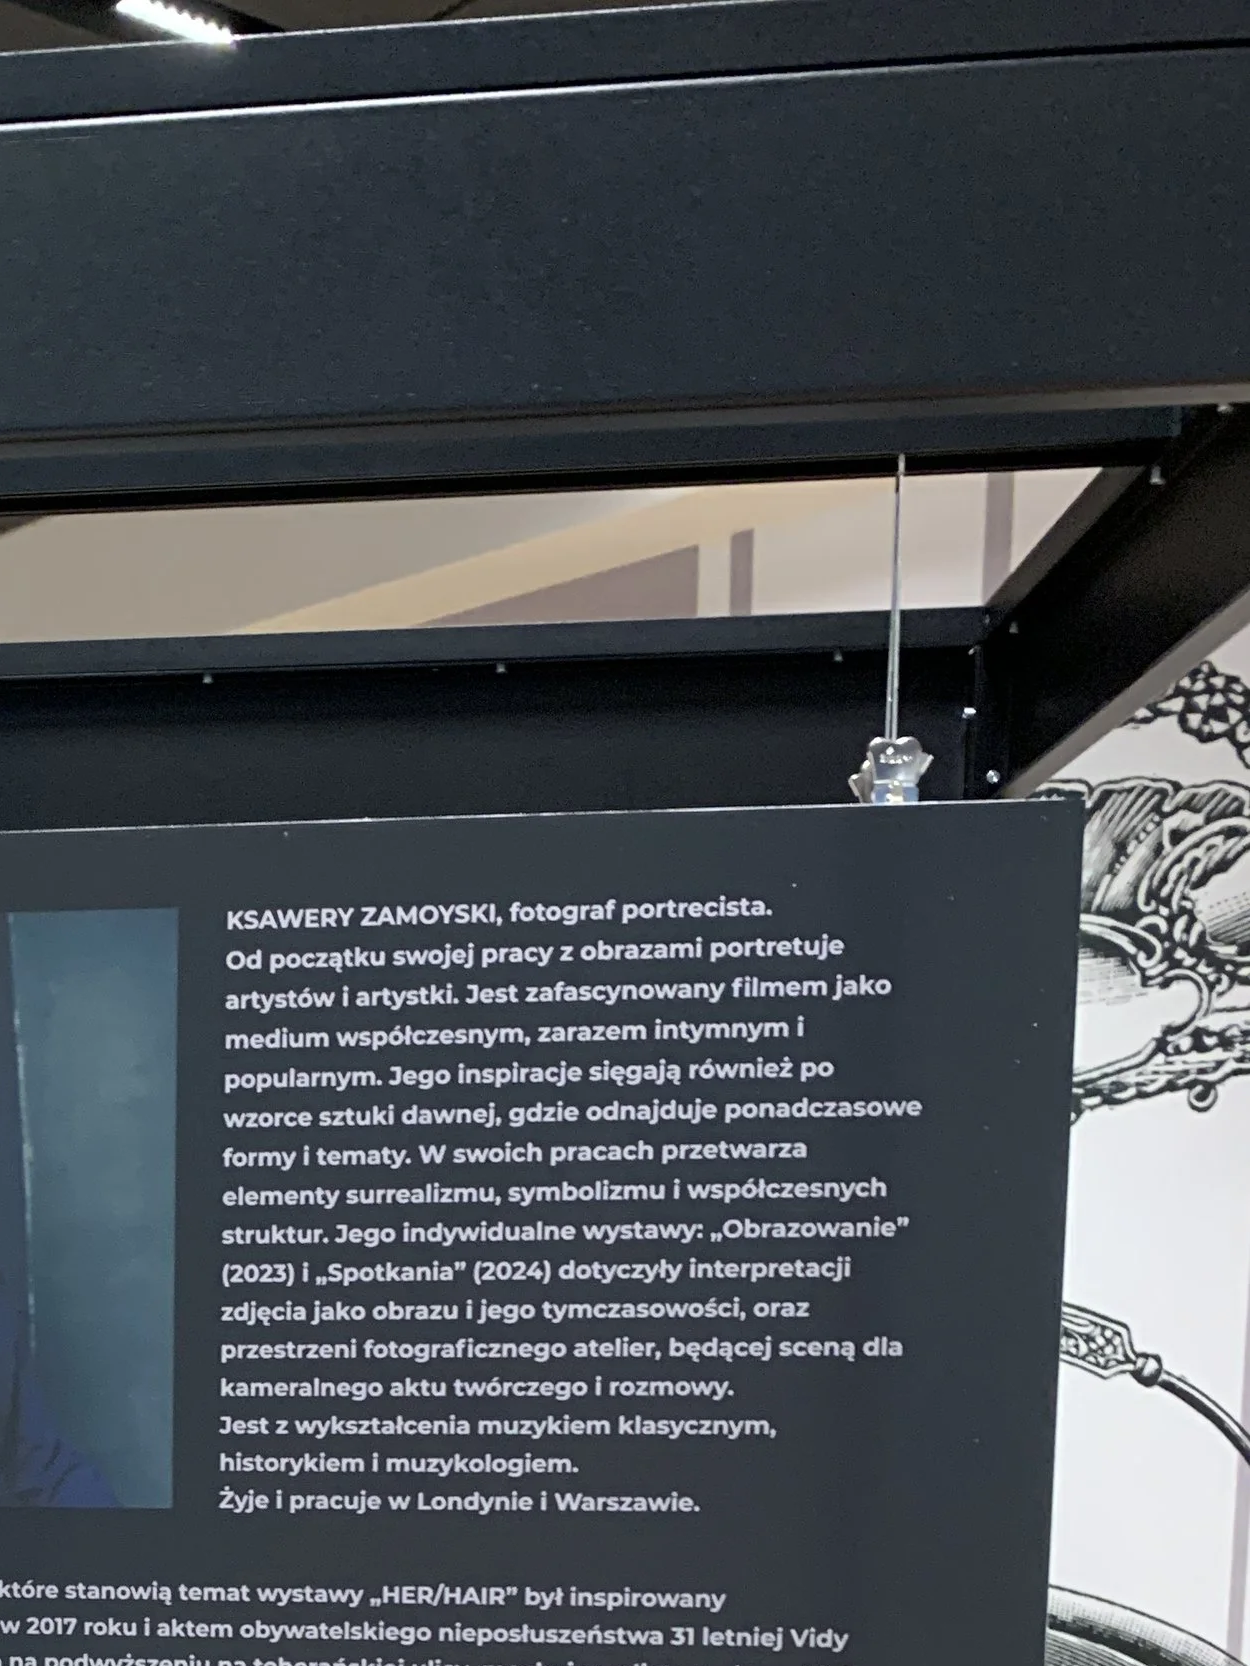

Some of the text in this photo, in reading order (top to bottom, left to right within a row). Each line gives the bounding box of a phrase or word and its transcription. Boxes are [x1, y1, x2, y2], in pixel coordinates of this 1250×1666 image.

[226, 894, 774, 931] KSAWERY ZAMOYSKI, fotograf portrecista.
[225, 932, 846, 975] Od początku swojej pracy z obrazami portretuje
[224, 1014, 805, 1052] medium współczesnym, zarazem intymnym i
[224, 1055, 835, 1094] popularnym. Jego inspiracje sięgają również po
[222, 1096, 923, 1129] wzorce sztuki dawnej, gdzie odnajduje ponadczasowe
[221, 1176, 888, 1210] elementy surrealizmu, symbolizmu i współczesnych
[221, 1223, 330, 1245] struktur.
[333, 1223, 397, 1248] Jego
[402, 1220, 577, 1247] indywidualne
[581, 1220, 704, 1245] wystawy:
[221, 1262, 296, 1288] (2023)
[301, 1261, 310, 1283] i
[472, 1259, 552, 1286] (2024)
[557, 1258, 684, 1285] dotyczyły
[688, 1255, 852, 1283] interpretacji
[220, 1334, 904, 1364] przestrzeni fotograficznego atelier, będącej sceną dla
[218, 1413, 777, 1440] Jest z wykształcenia muzykiem klasycznym,
[64, 1580, 173, 1606] stanowią
[177, 1583, 251, 1603] temat
[255, 1585, 365, 1608] wystawy
[524, 1586, 565, 1611] był
[569, 1585, 727, 1614] inspirowany
